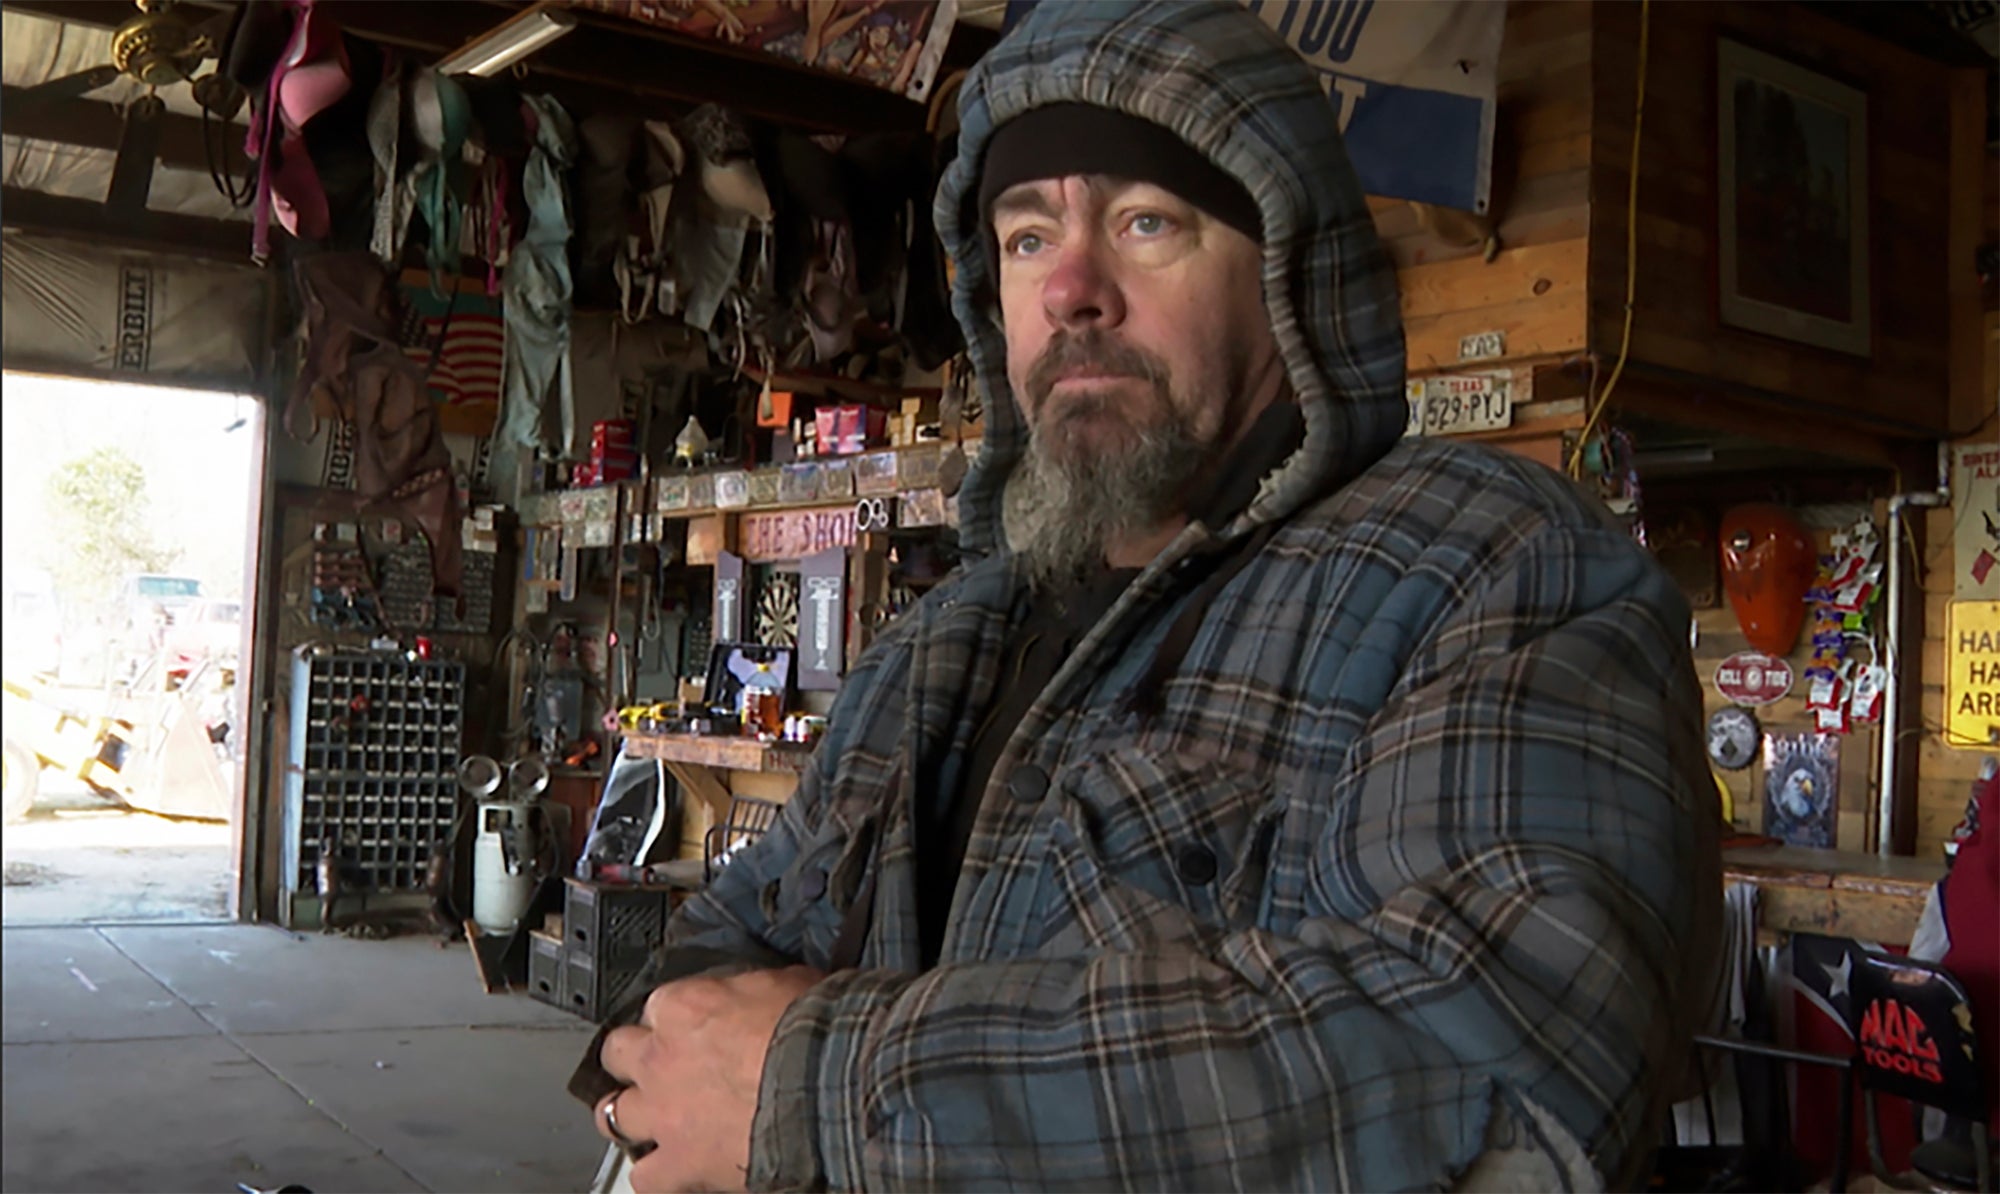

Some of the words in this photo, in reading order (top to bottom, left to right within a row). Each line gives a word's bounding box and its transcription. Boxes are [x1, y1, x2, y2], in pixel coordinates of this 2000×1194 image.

[1449, 378, 1484, 394] TEXAS
[746, 515, 785, 555] THE
[1859, 997, 1941, 1063] MAC
[1862, 1045, 1944, 1084] TOOLS
